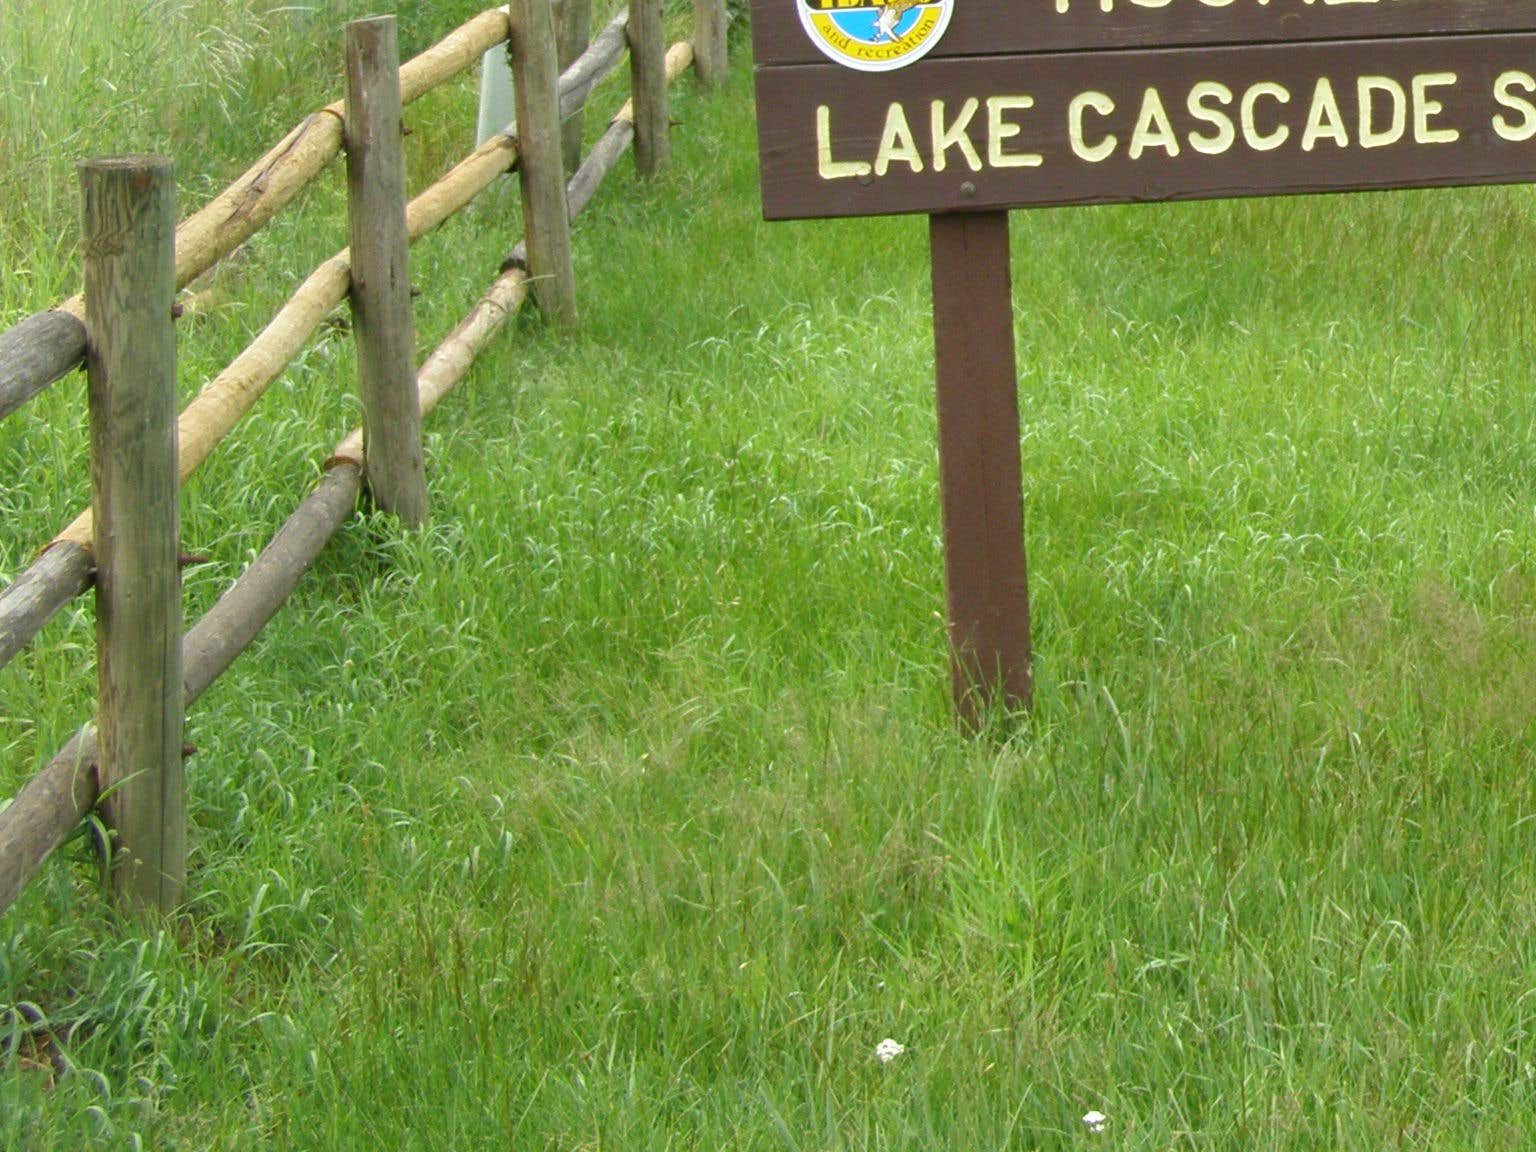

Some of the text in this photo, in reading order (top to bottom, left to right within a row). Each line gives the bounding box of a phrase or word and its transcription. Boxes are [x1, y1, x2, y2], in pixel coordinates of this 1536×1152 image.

[823, 18, 935, 58] and recreation
[816, 95, 1043, 180] LAKE
[1068, 72, 1460, 163] CASCADE
